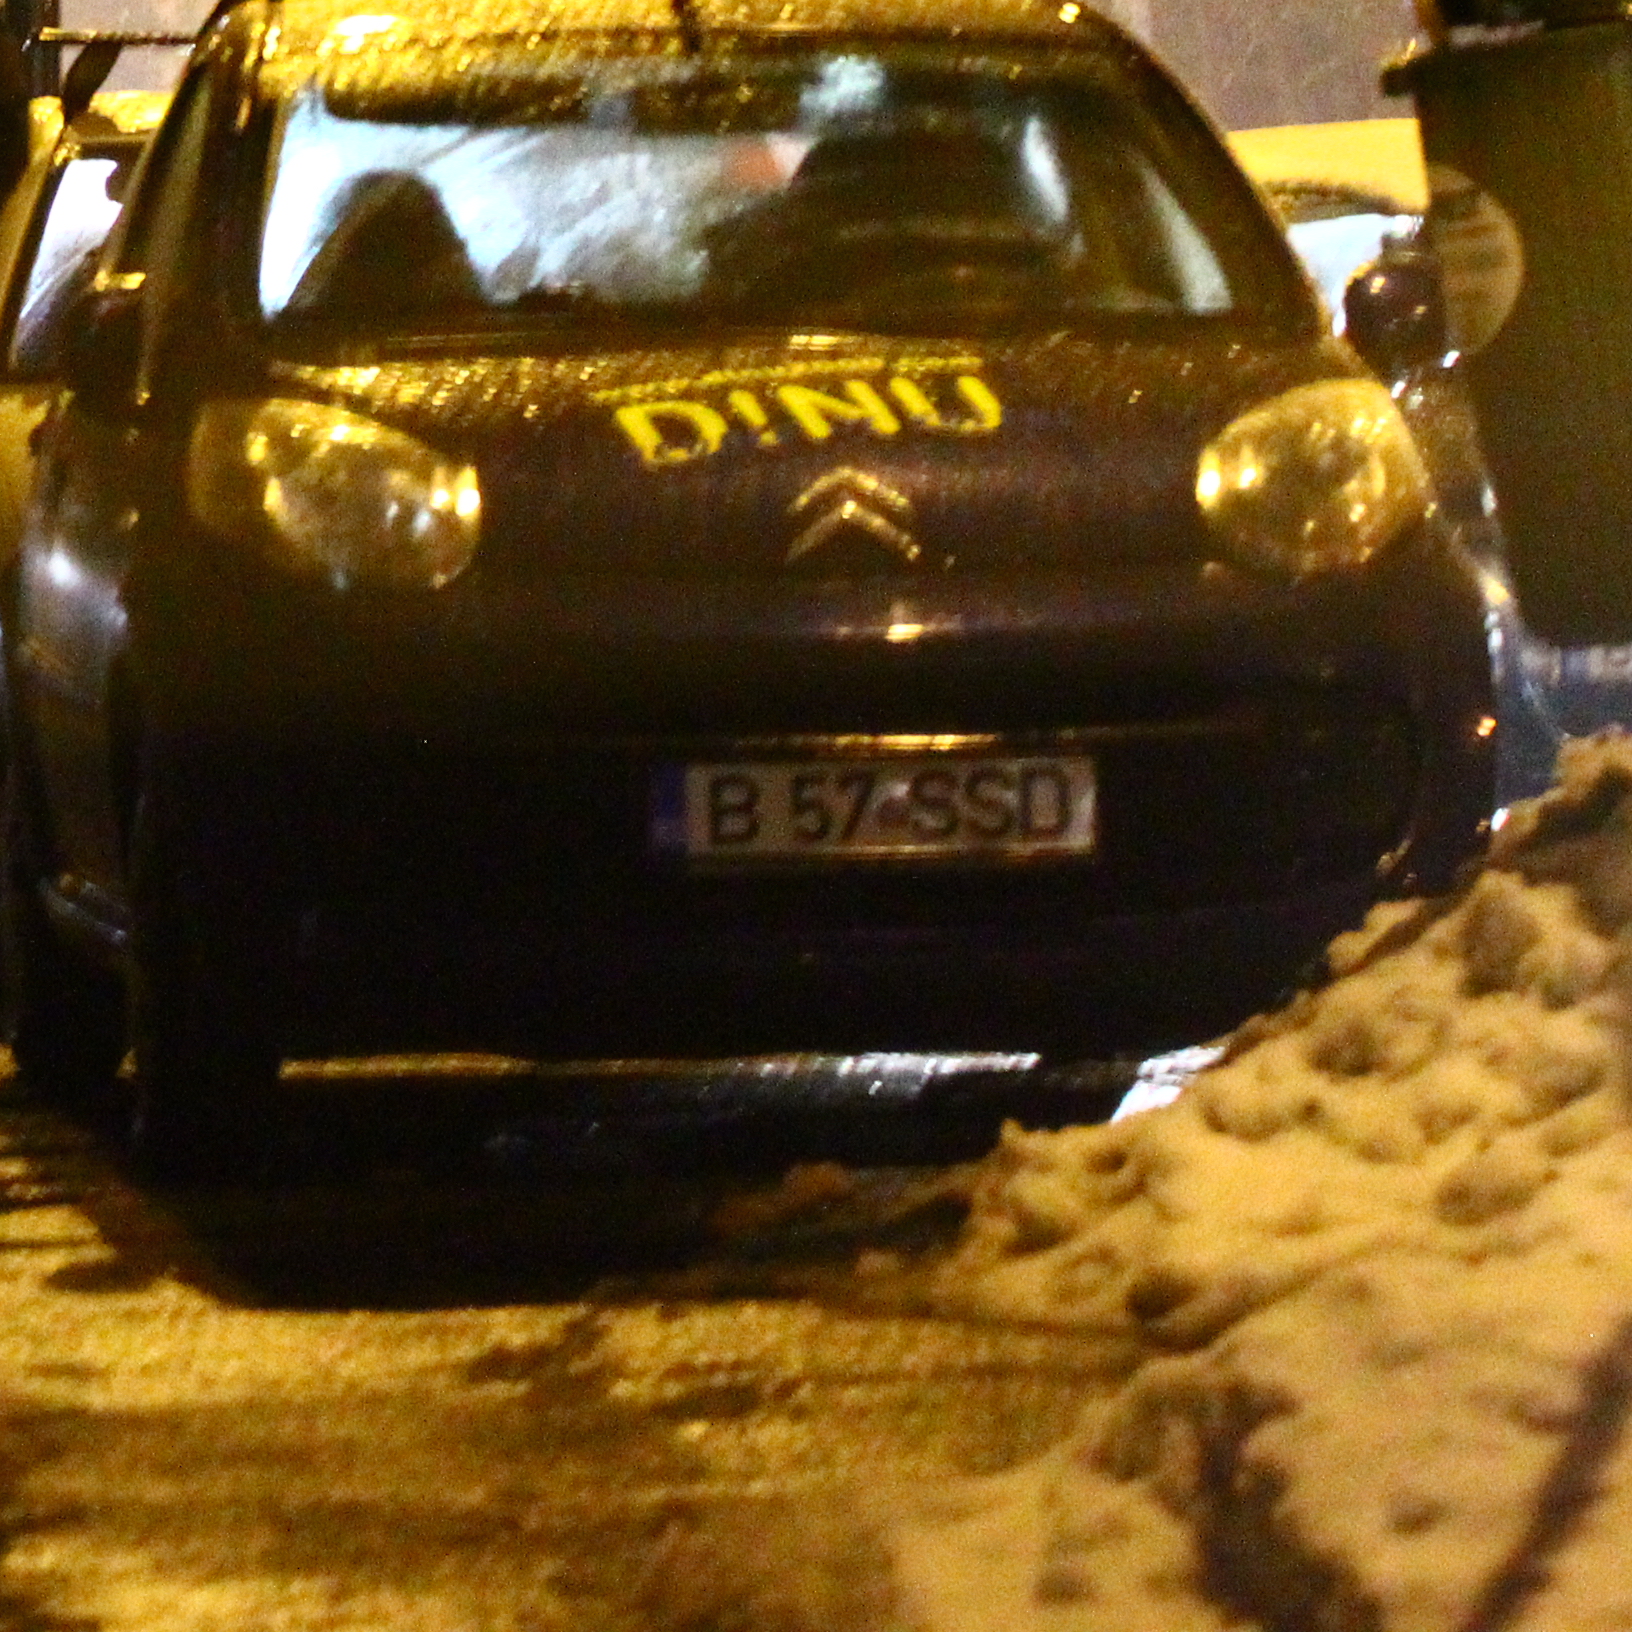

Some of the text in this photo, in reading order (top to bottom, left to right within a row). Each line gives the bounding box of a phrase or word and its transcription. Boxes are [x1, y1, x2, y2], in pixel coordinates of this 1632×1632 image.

[615, 376, 1003, 465] DINU
[710, 767, 1070, 846] B 57 SSD
